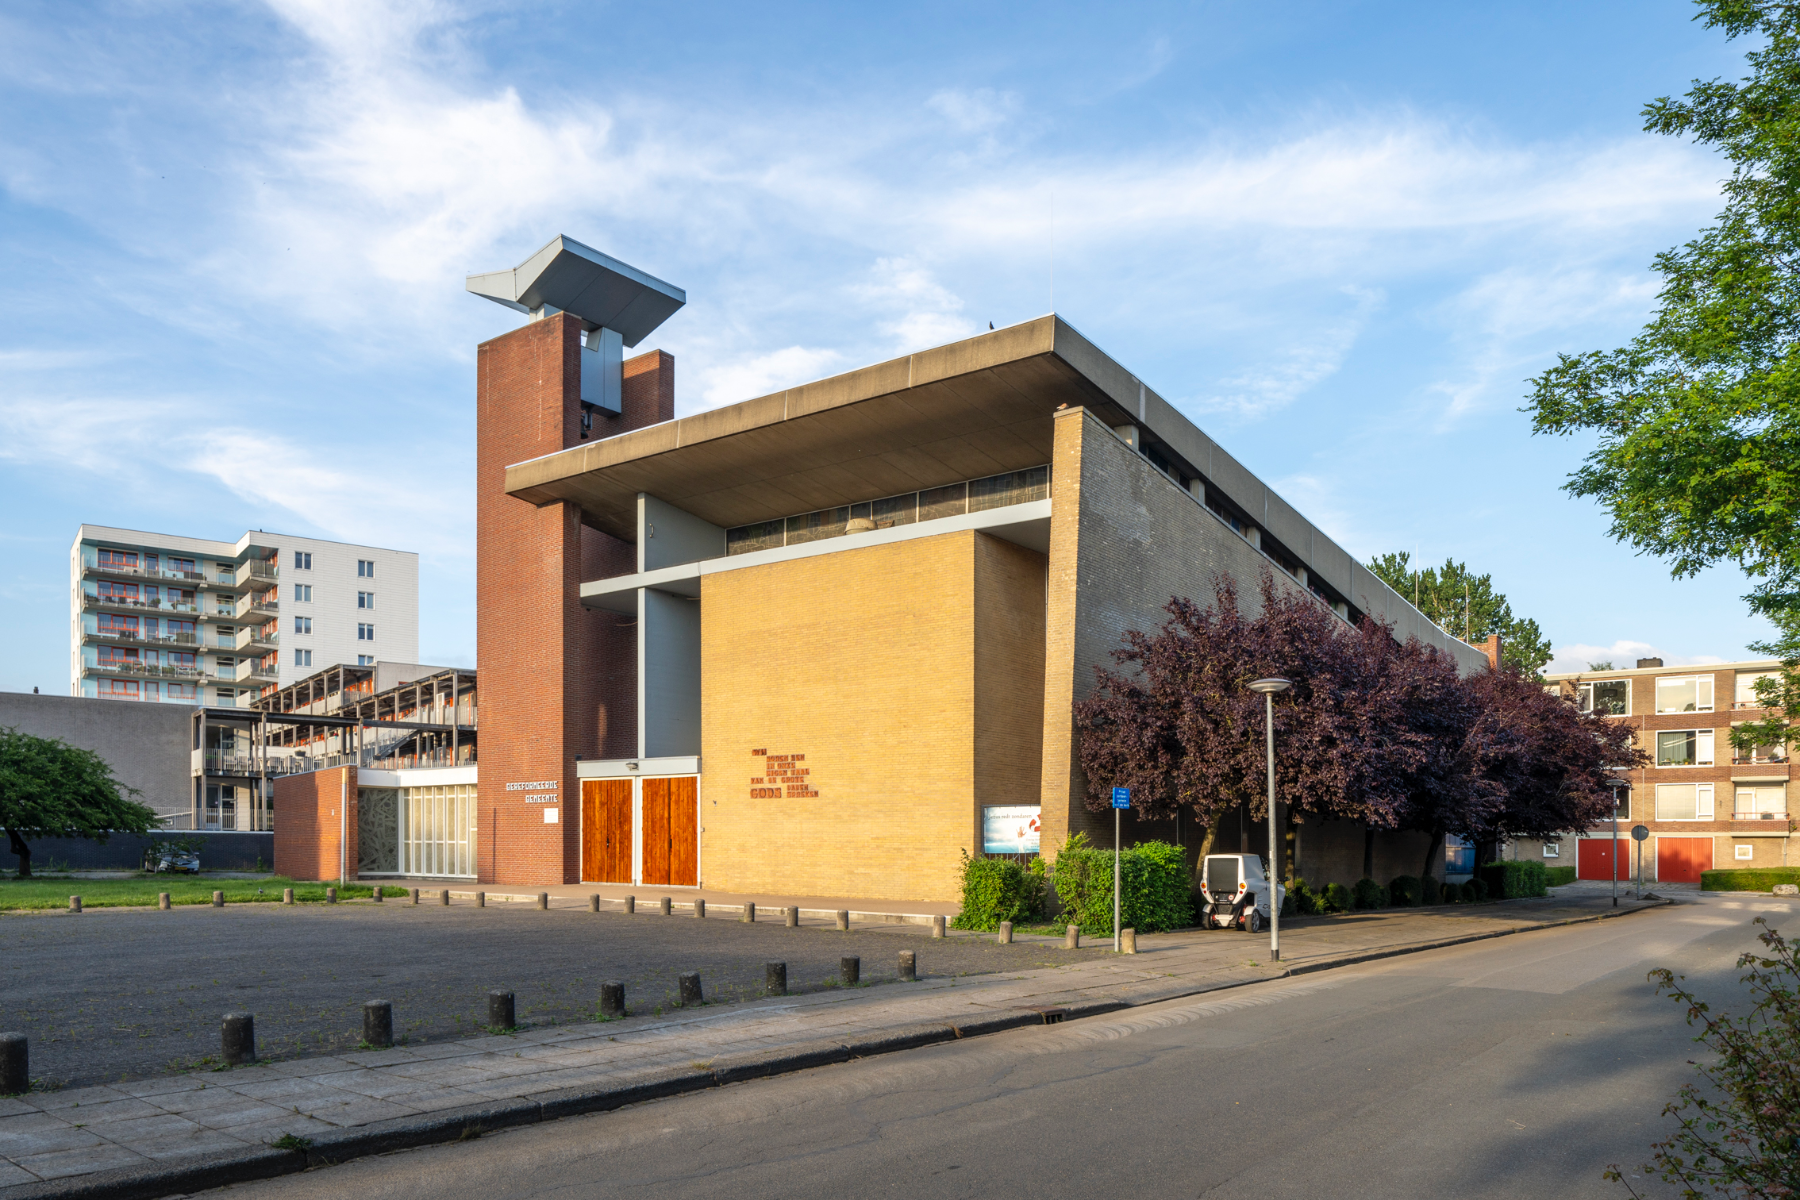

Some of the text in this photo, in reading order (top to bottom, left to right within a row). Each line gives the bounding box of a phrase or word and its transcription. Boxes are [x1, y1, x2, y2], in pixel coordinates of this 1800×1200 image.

[506, 781, 558, 791] GEREFORMEERDE
[525, 794, 558, 803] GEMEENTE
[750, 788, 782, 799] GODS
